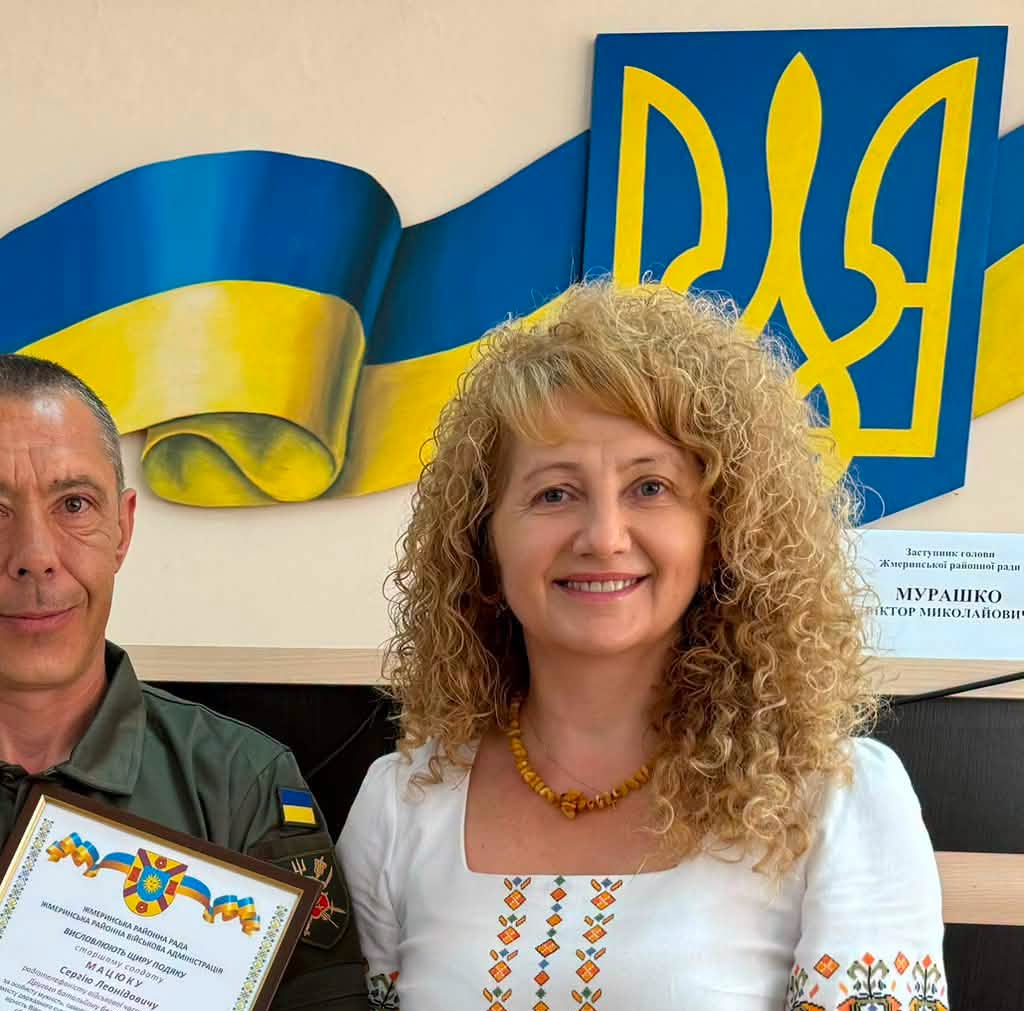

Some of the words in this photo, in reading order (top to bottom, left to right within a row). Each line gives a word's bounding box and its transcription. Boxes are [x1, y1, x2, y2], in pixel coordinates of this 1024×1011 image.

[880, 559, 947, 570] Жмеринської
[950, 561, 995, 571] районної
[905, 548, 958, 558] Заступник
[896, 587, 1002, 604] МУРАШКО
[920, 606, 1024, 619] МИКОЛАЙОВИ
[40, 900, 90, 924] ЖМЕРИНСЬКА
[90, 919, 126, 938] РАЙОННА
[126, 932, 166, 953] ВІЙСЬКОВА
[166, 948, 223, 975] АДМІНІСТРАЦІЯ
[82, 905, 132, 929] ЖМЕРИНСЬКА
[132, 924, 168, 943] РАЙОННА
[168, 938, 188, 951] РАДА
[63, 926, 127, 957] ВИСЛОВЛЮЮТЬ
[126, 951, 152, 967] ЩИРУ
[151, 960, 186, 980] ПОДЯКУ
[73, 944, 122, 968] старшому
[123, 962, 164, 984] солдату
[58, 965, 94, 986] Сергію
[94, 978, 159, 1011] Леонідовичу
